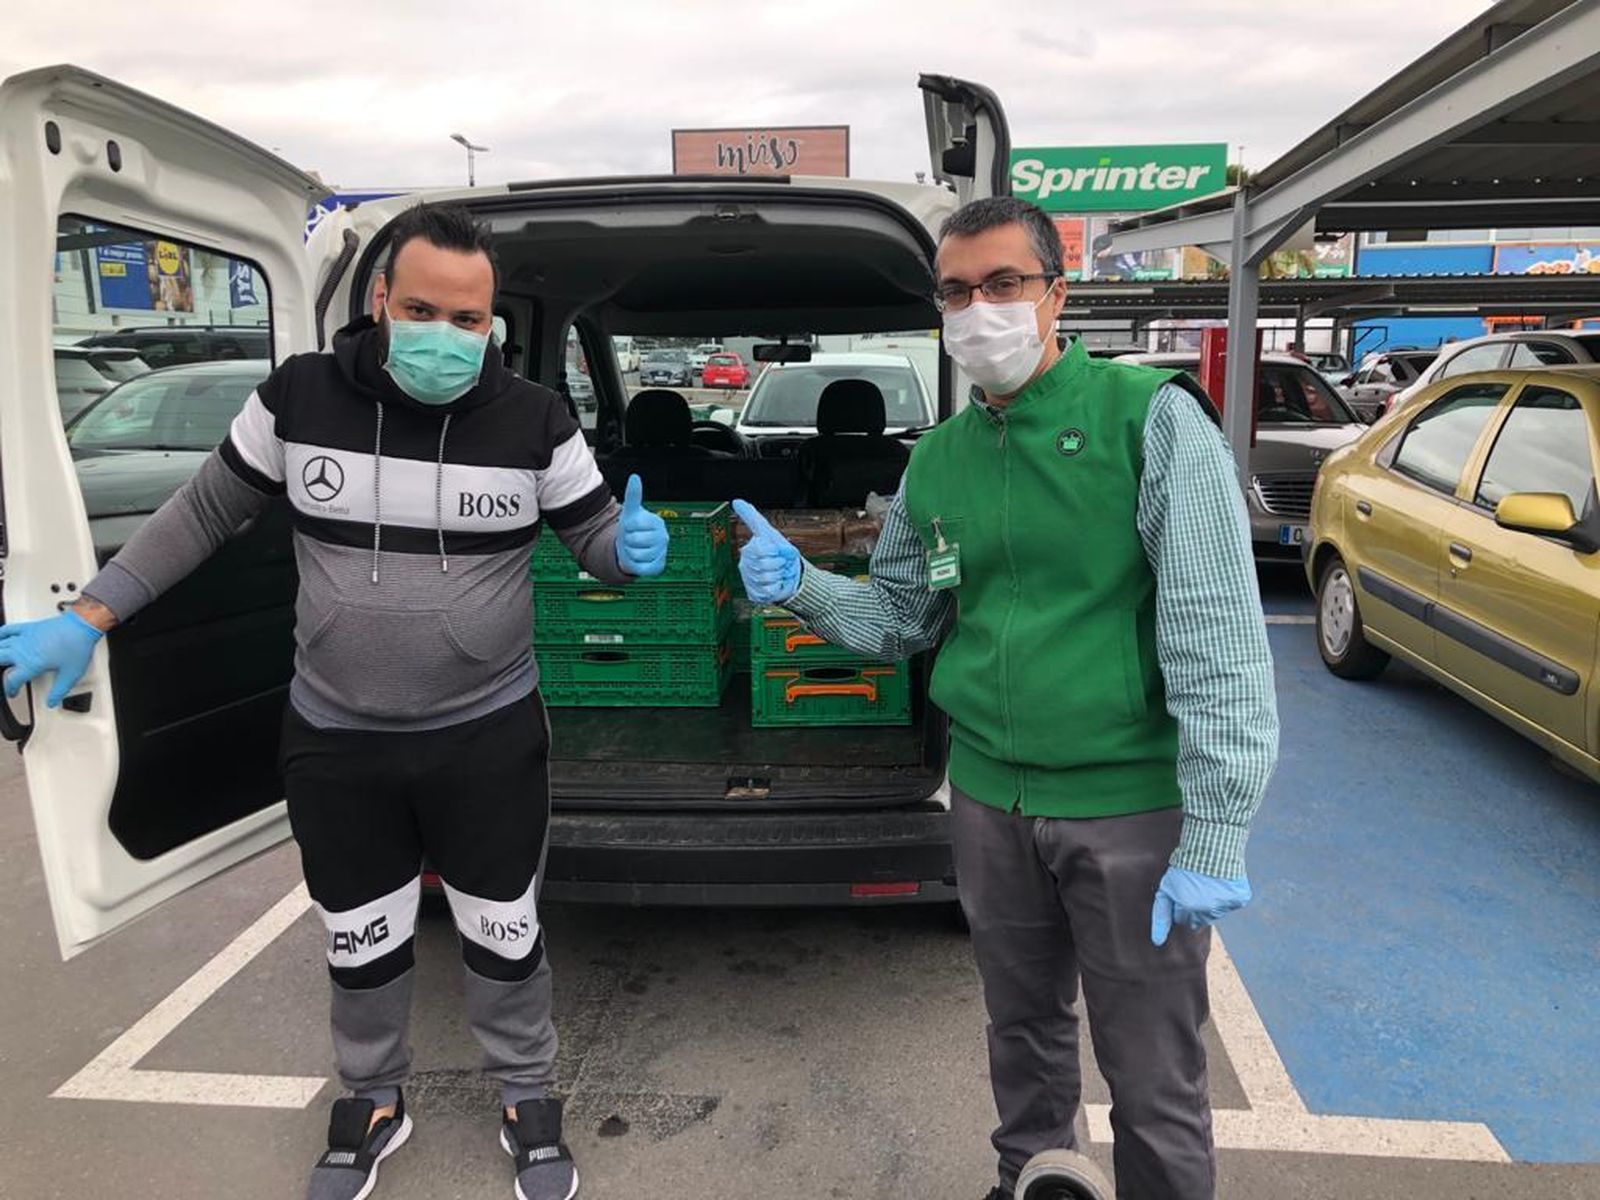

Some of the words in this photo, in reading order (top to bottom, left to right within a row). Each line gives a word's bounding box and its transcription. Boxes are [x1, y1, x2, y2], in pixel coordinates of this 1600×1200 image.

[1011, 157, 1211, 199] Sprinter
[458, 492, 521, 519] BOSS
[480, 914, 529, 942] BOSS
[325, 1151, 357, 1165] PUMA
[528, 1146, 560, 1162] PUMA
